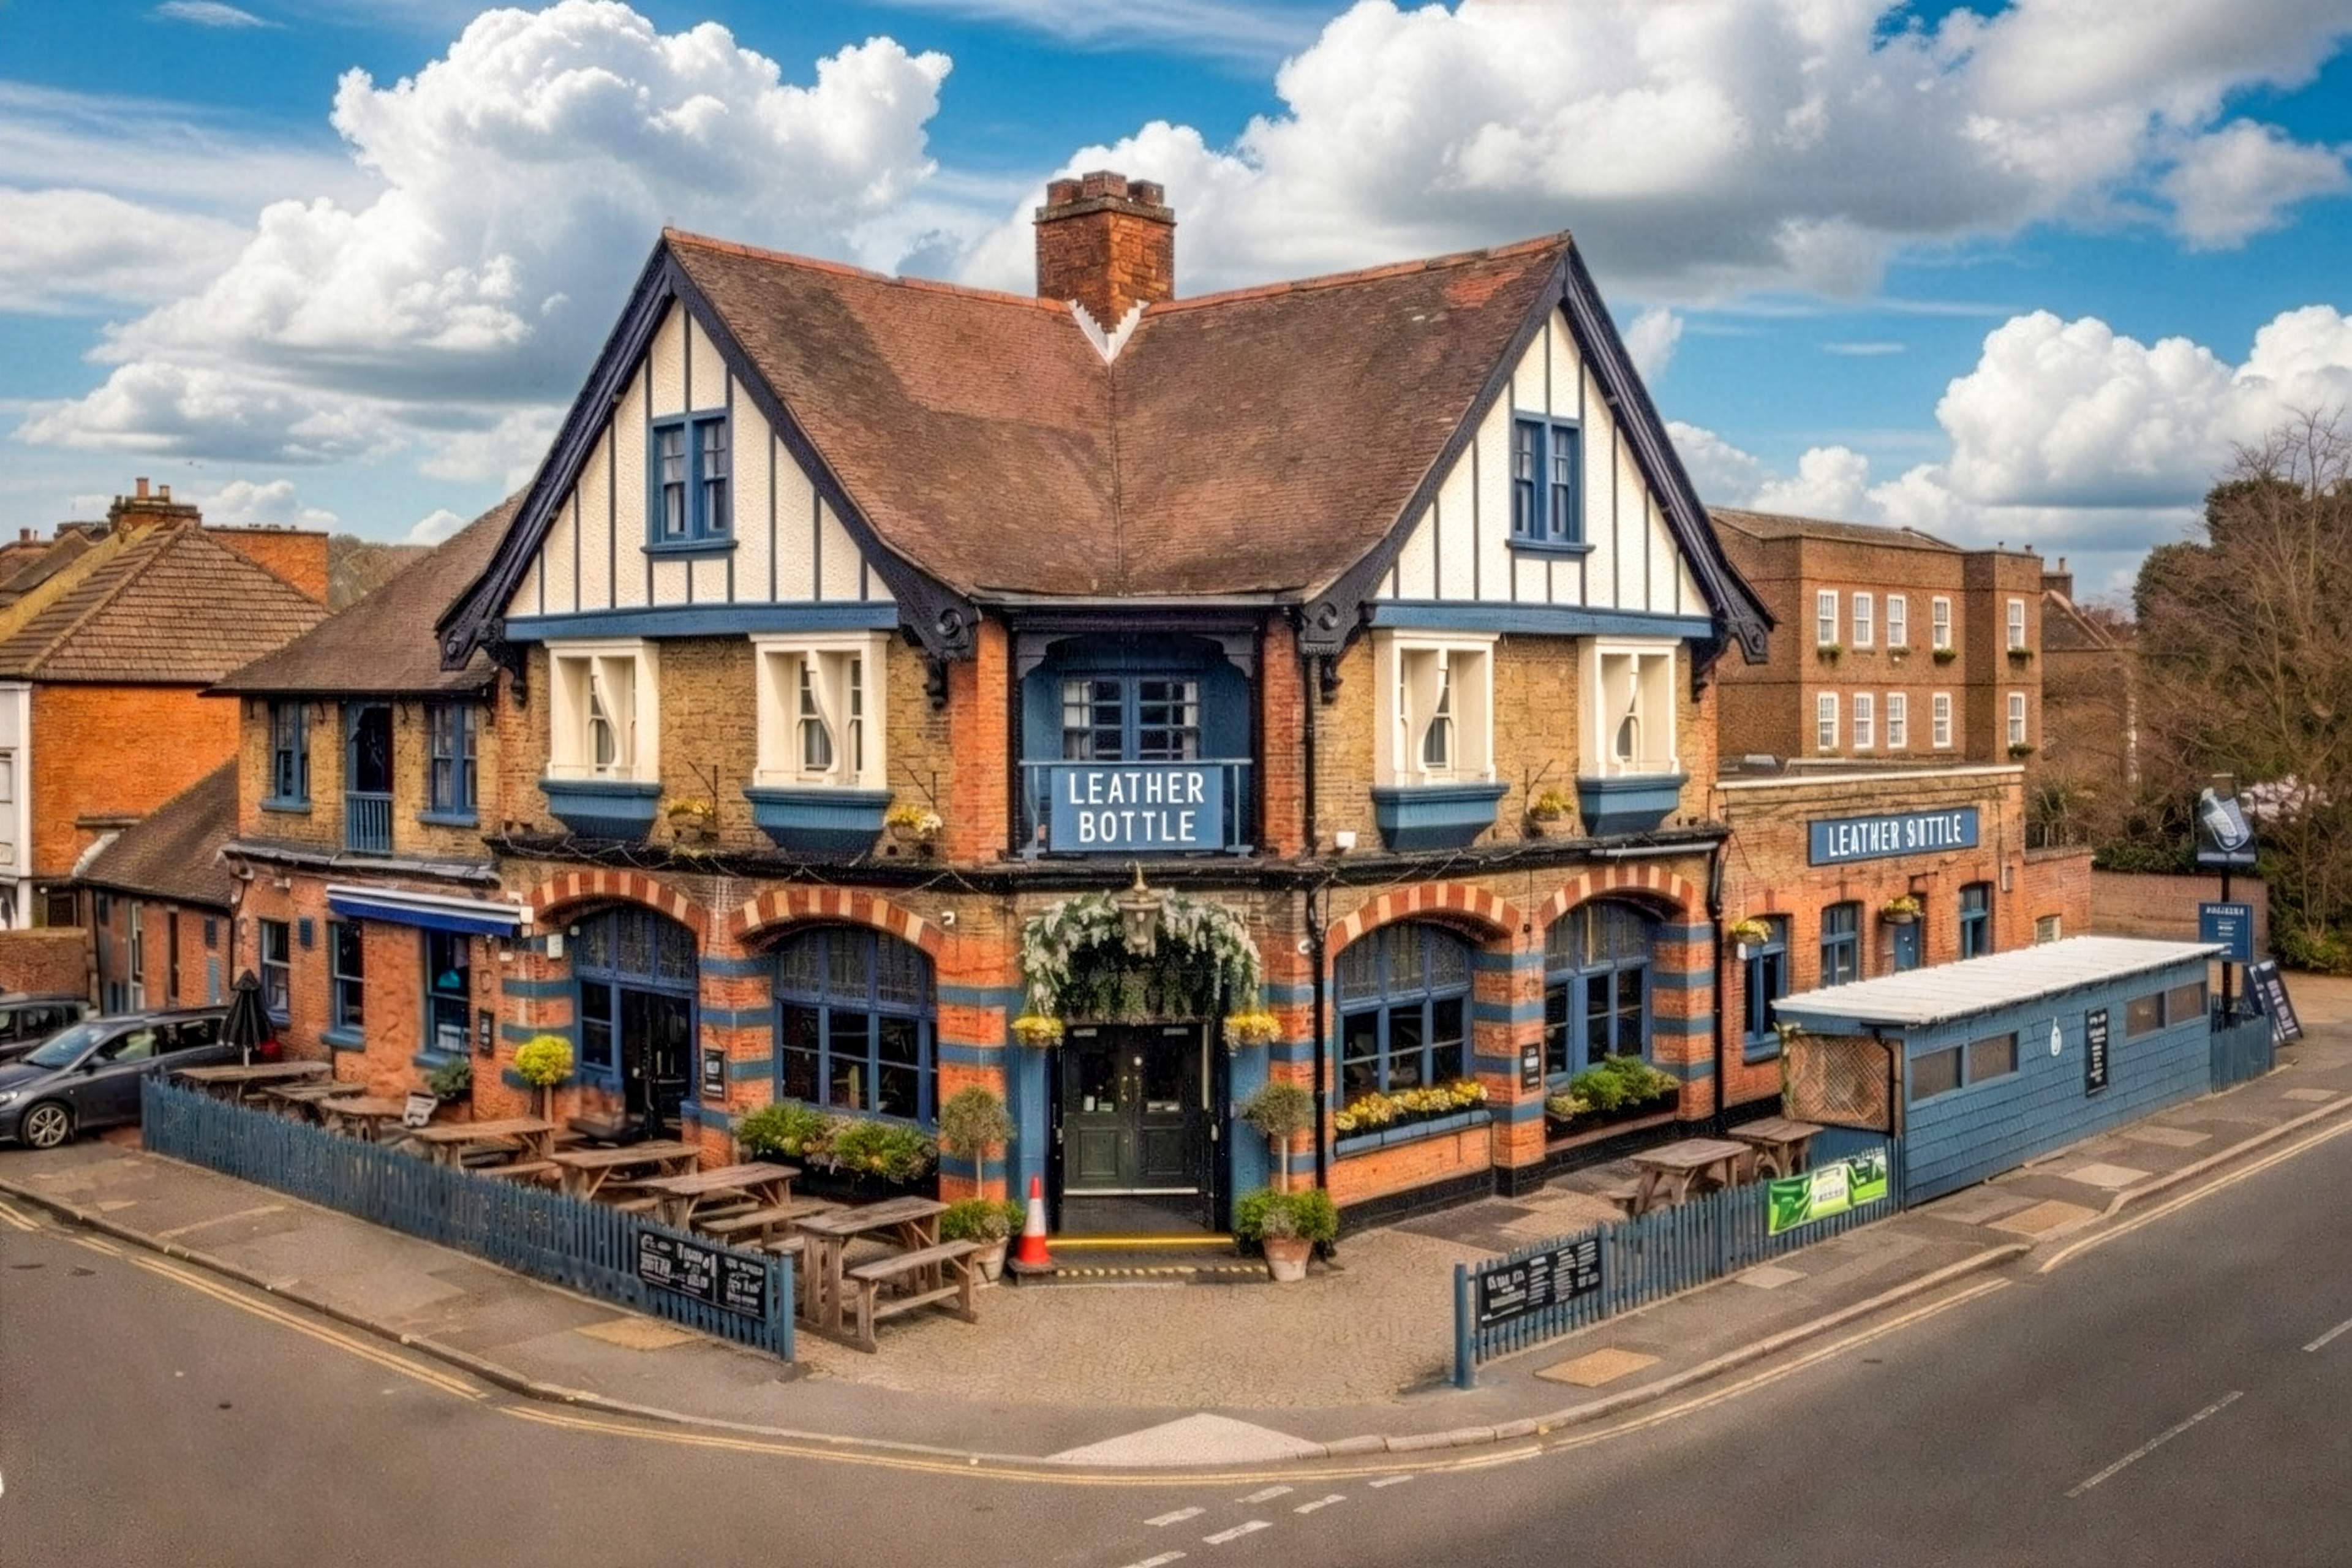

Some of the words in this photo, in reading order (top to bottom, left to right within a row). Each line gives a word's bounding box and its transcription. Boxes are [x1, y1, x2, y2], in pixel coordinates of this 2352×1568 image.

[1069, 772, 1205, 804] LEATHER
[1079, 810, 1196, 843] BOTTLE
[1828, 820, 1900, 857] LEATHER
